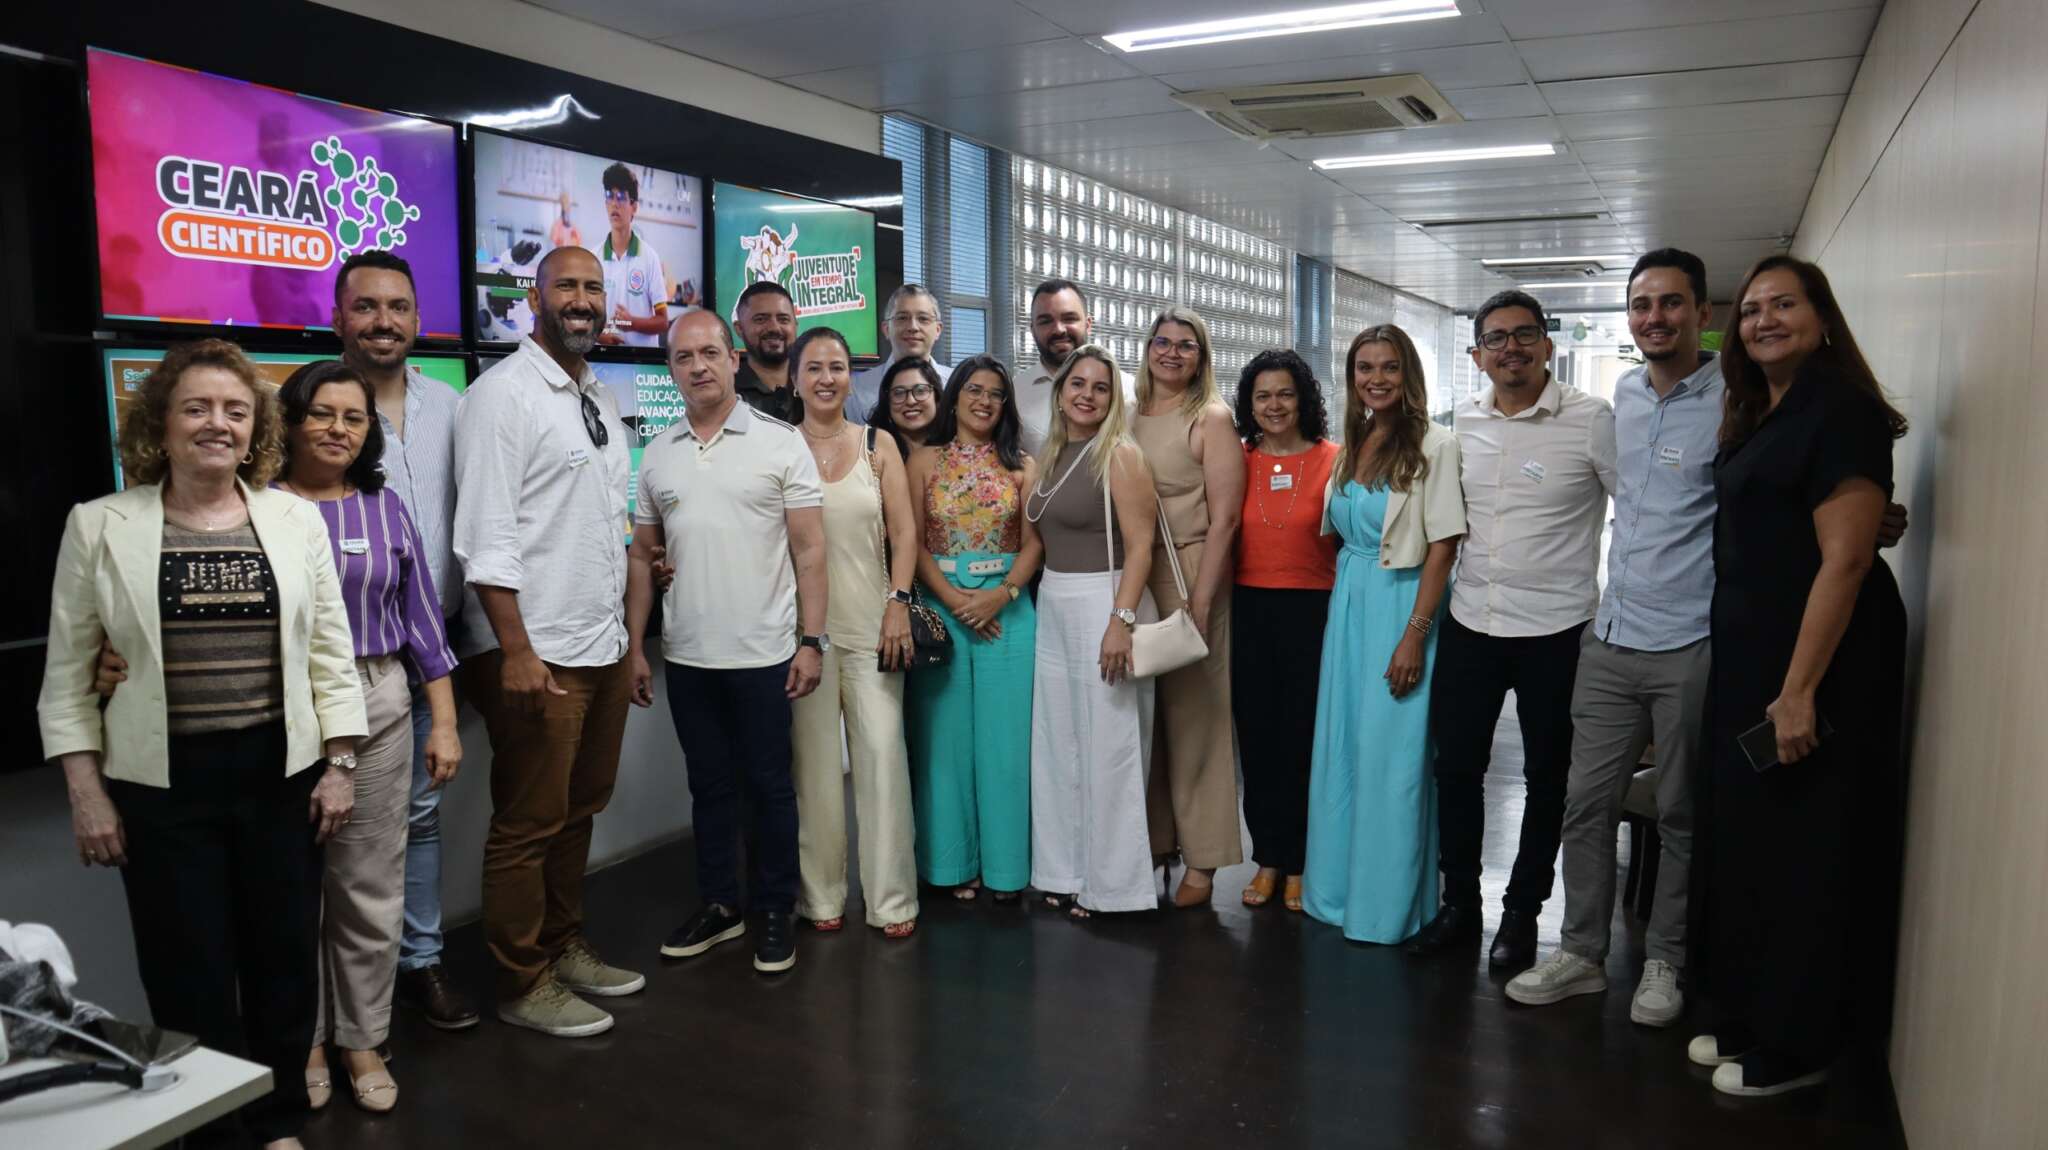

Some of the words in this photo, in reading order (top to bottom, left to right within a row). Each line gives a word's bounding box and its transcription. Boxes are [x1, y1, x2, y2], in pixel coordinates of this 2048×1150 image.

[159, 158, 325, 225] CEARÁ
[171, 220, 326, 262] CIENTÍFICO
[795, 255, 857, 281] JUVENTUDE
[811, 277, 821, 288] EM
[822, 275, 843, 287] TEMPO
[796, 277, 861, 308] INTEGRAL
[636, 374, 674, 387] CUIDAR
[638, 406, 687, 421] AVANÇAR
[181, 560, 261, 591] JUMP
